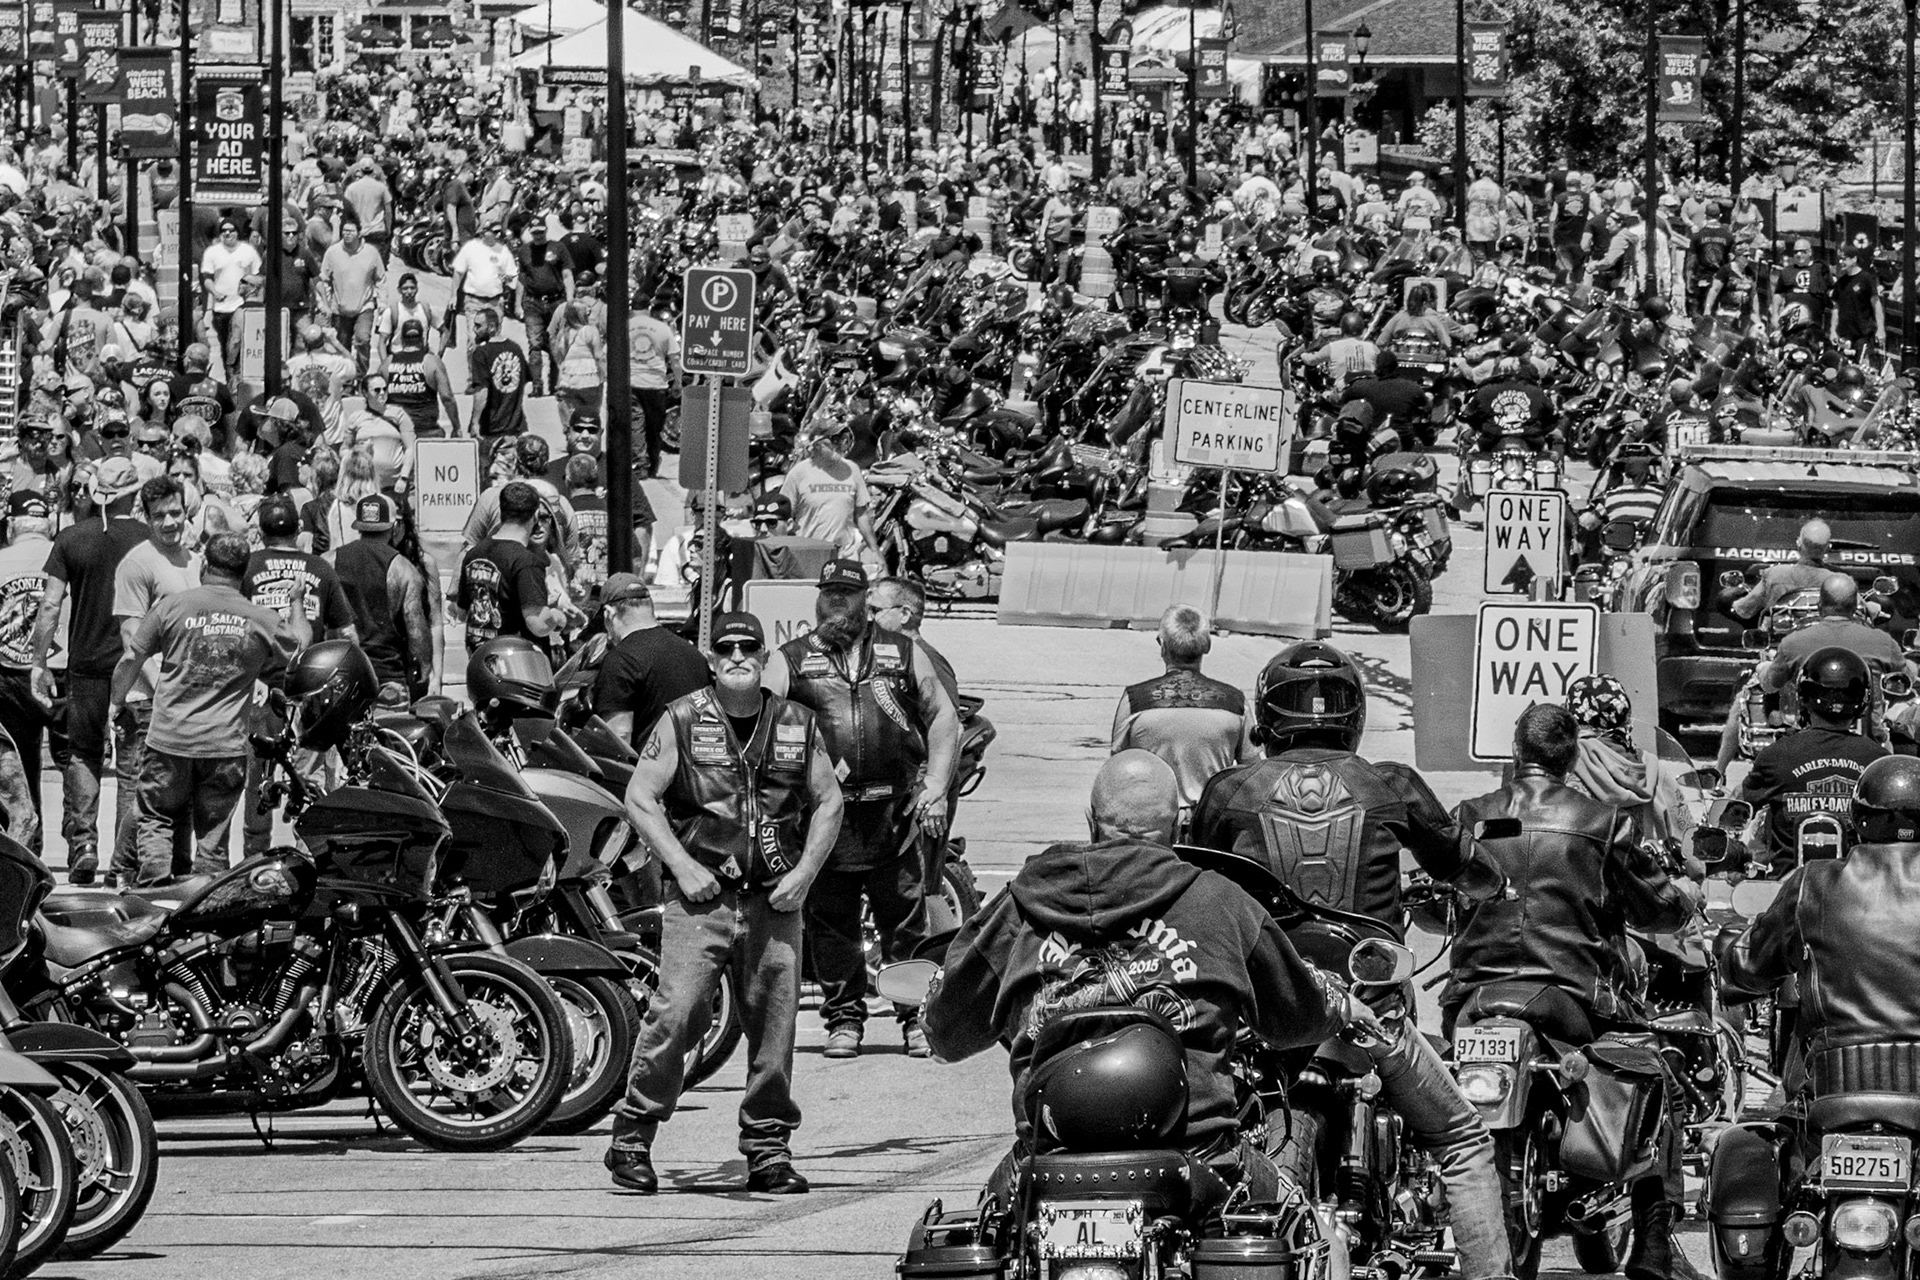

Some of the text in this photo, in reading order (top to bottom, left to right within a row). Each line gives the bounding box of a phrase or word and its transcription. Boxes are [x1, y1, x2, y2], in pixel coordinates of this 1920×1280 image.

[84, 37, 118, 47] BEACH
[1665, 66, 1697, 76] BEACH
[1667, 59, 1695, 67] WEIRS
[129, 77, 164, 88] WEIRS
[127, 87, 167, 99] BEACH
[204, 122, 255, 140] YOUR
[216, 140, 243, 157] AD
[206, 158, 256, 175] HERE.
[712, 282, 729, 305] P
[688, 314, 747, 331] PAY HERE
[1183, 398, 1278, 422] CENTERLINE
[1191, 431, 1264, 453] PARKING
[435, 465, 459, 482] NO
[422, 493, 473, 506] PARKING
[1500, 497, 1550, 522] ONE
[1495, 525, 1551, 550] WAY
[265, 559, 307, 571] BOSTON
[1714, 547, 1916, 565] LACONIA POLICE
[185, 612, 247, 630] OLD SALTY
[203, 624, 247, 637] BASTARDS
[1495, 616, 1579, 652] ONE
[1491, 660, 1580, 696] WAY
[1792, 758, 1865, 778] HARLEY-DAVIDS
[761, 826, 778, 854] SIN
[1128, 958, 1160, 975] 2015
[1457, 1038, 1516, 1056] 971331
[1831, 1155, 1901, 1178] 582751
[1076, 1221, 1104, 1245] AL
